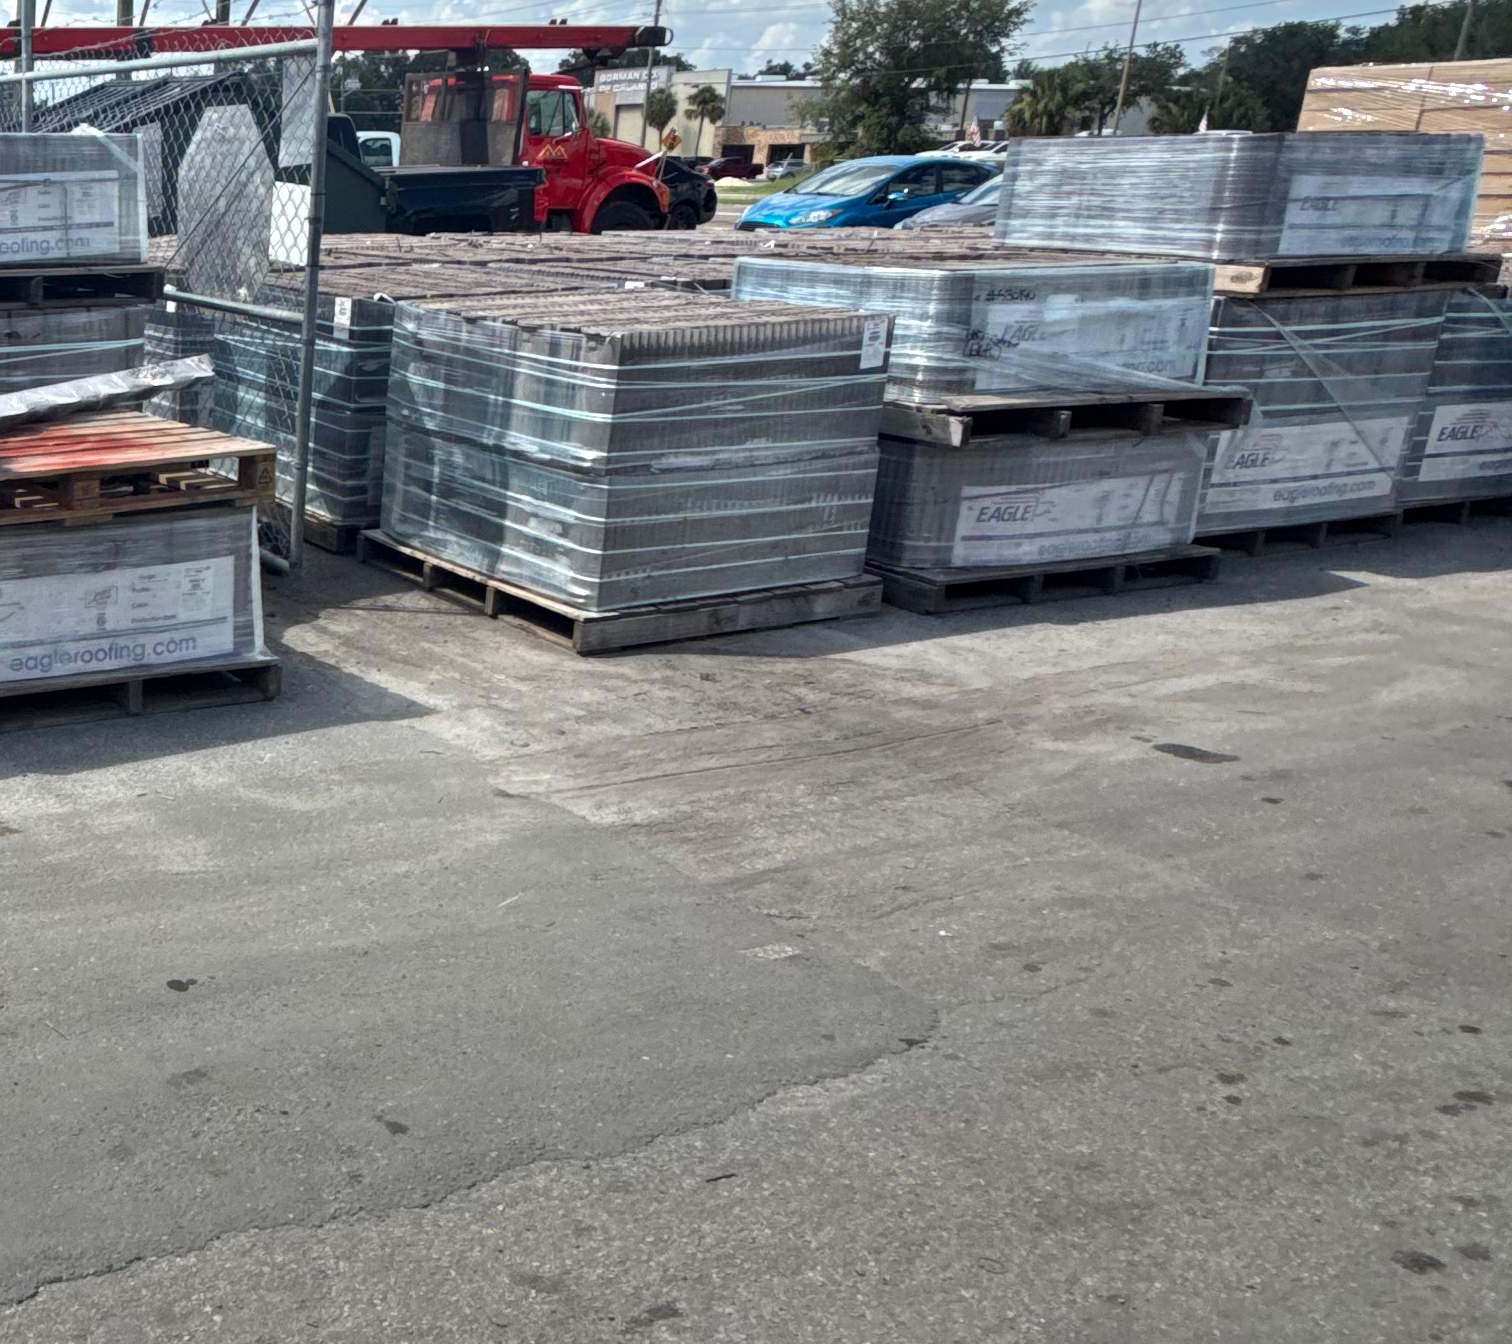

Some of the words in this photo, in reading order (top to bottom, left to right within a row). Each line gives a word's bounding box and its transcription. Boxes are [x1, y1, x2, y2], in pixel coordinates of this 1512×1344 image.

[1436, 424, 1484, 443] EAGLE
[975, 504, 1033, 524] EAGLE
[8, 635, 198, 673] eagleroofing.com
